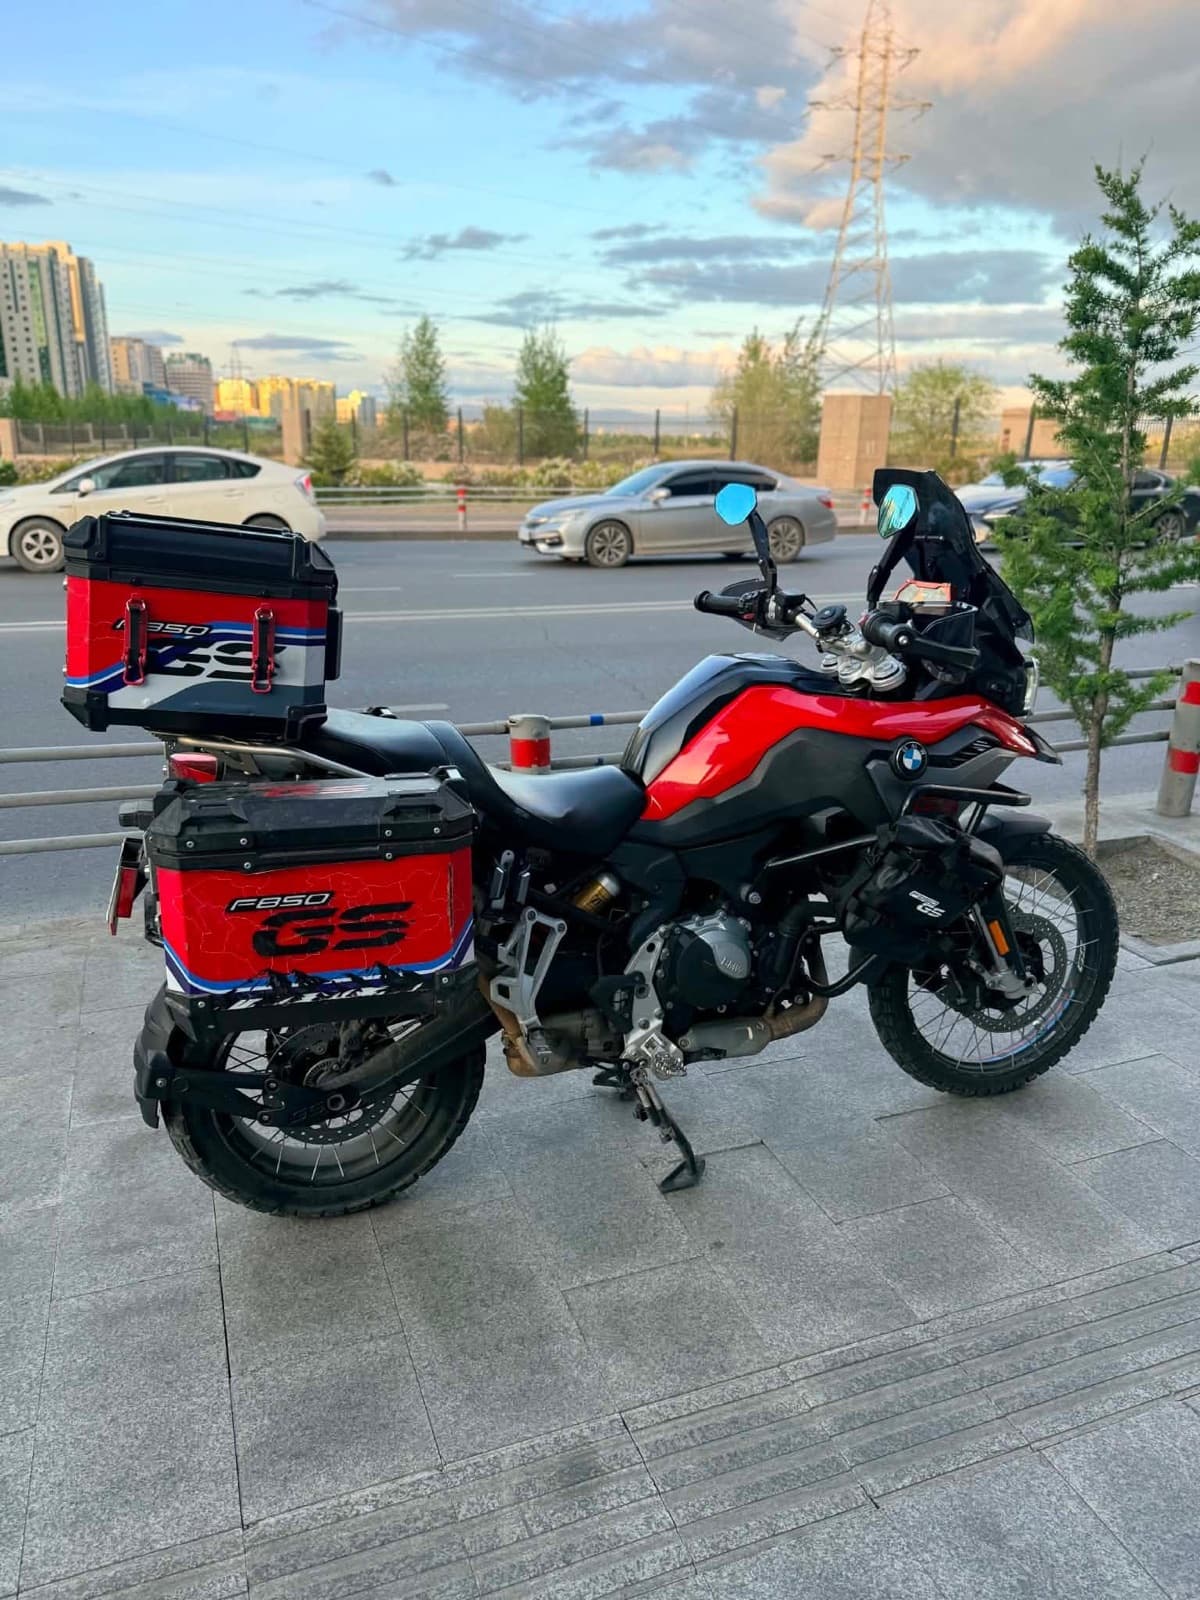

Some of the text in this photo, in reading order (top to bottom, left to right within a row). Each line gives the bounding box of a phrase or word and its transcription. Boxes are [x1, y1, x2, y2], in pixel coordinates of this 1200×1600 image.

[901, 743, 927, 756] BMW
[229, 893, 332, 912] F850
[916, 903, 946, 918] GS
[253, 902, 413, 957] GS
